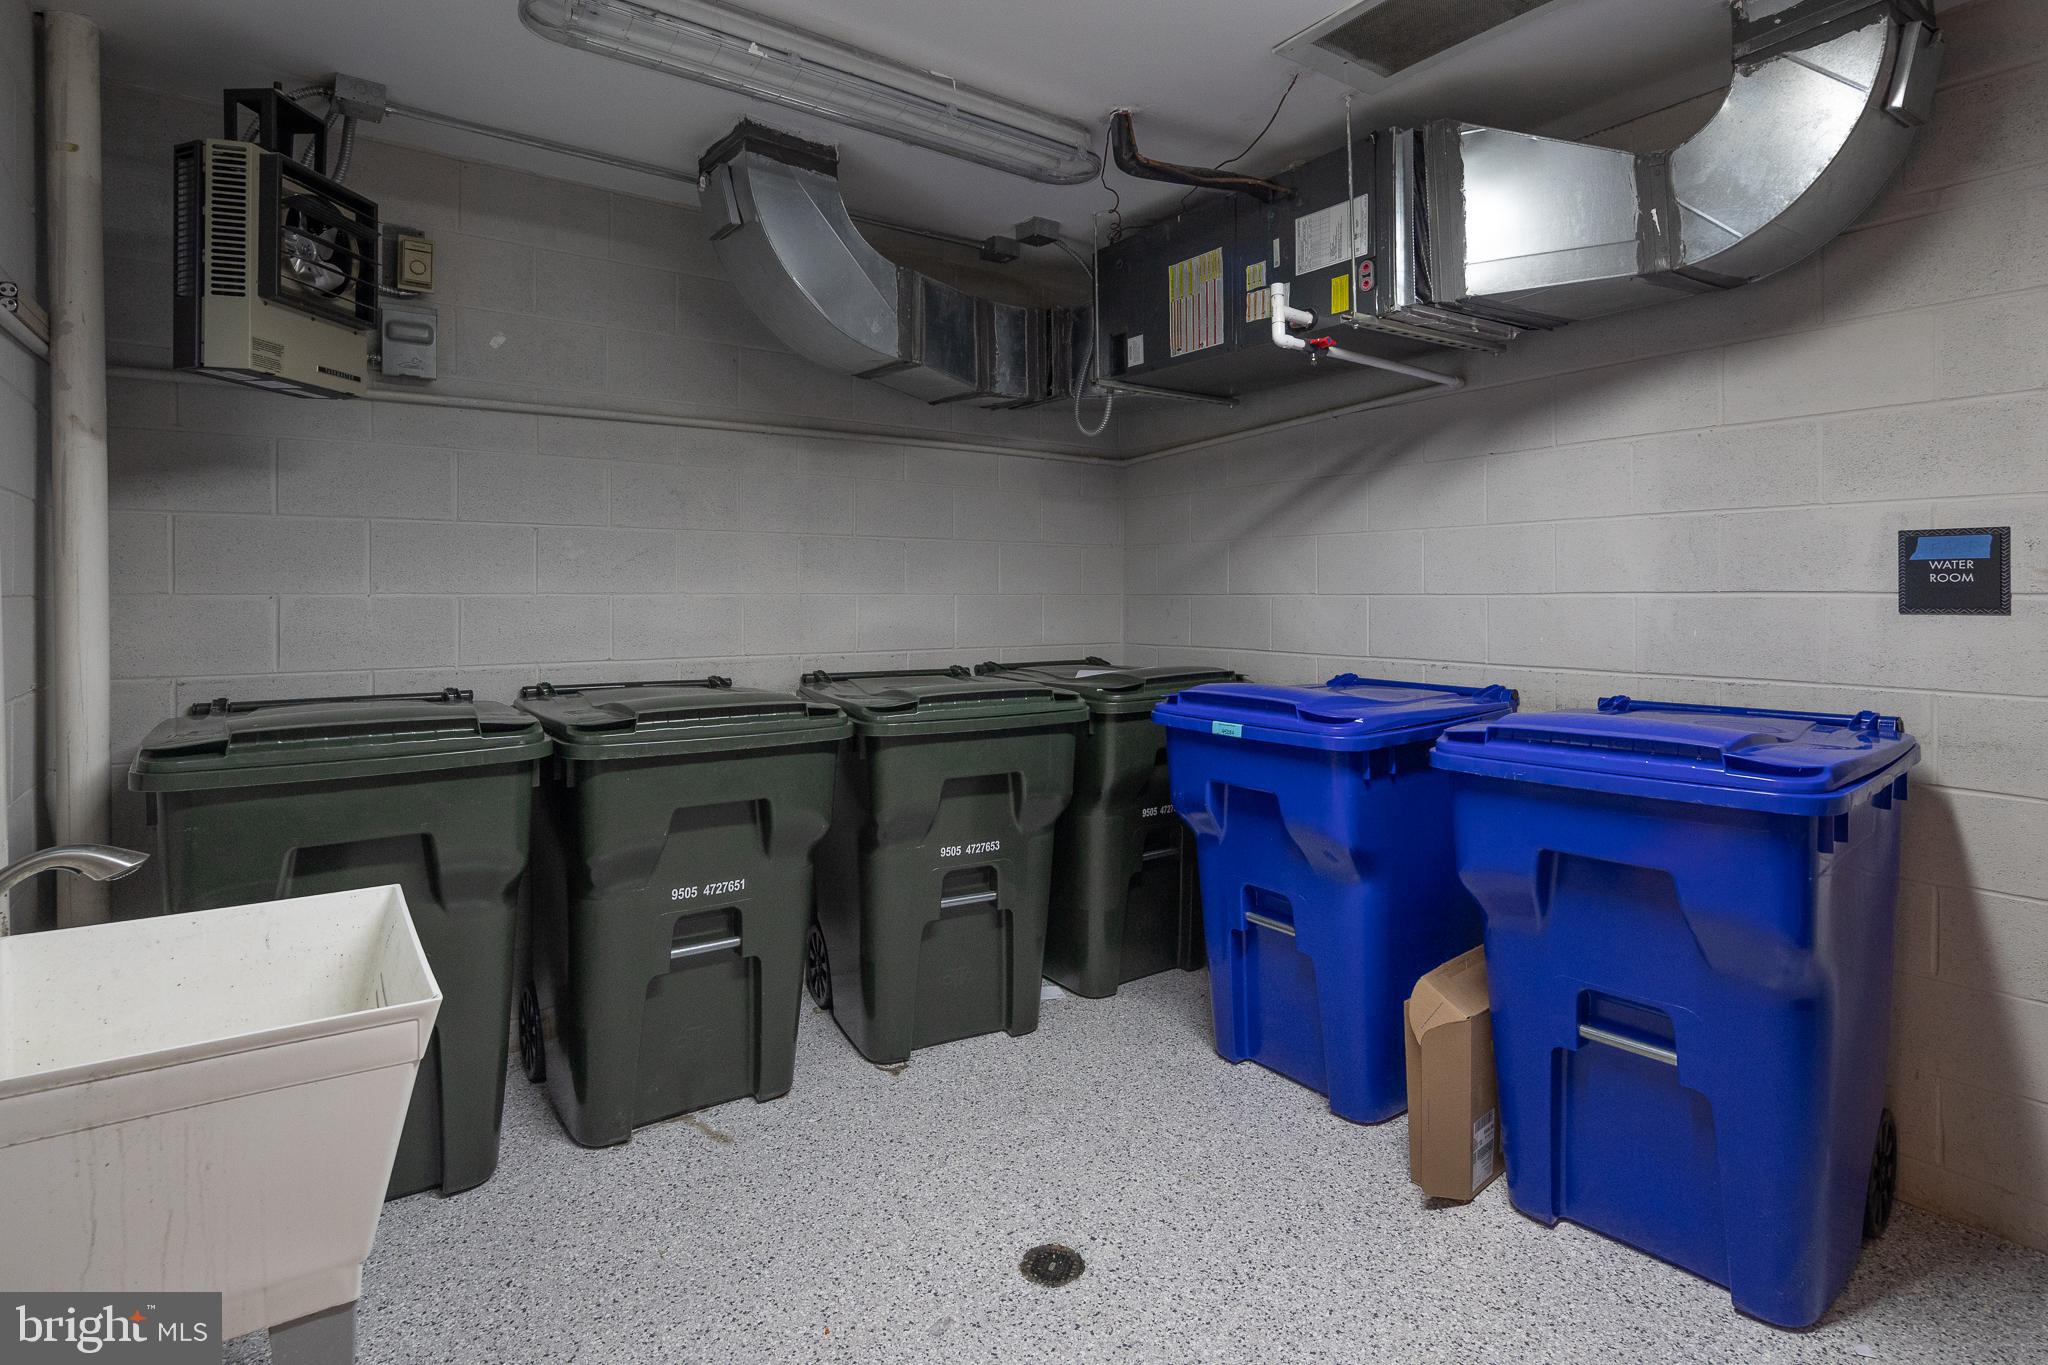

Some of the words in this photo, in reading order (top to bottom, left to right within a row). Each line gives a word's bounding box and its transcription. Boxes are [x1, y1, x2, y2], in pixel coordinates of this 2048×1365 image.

[1928, 560, 1974, 569] WATER
[1930, 573, 1974, 582] ROOM
[1142, 807, 1158, 818] 9505
[1160, 804, 1176, 815] 4727
[940, 845, 961, 857] 9505
[966, 841, 1000, 855] 4727653
[671, 886, 698, 900] 9505
[703, 878, 745, 896] 4727651
